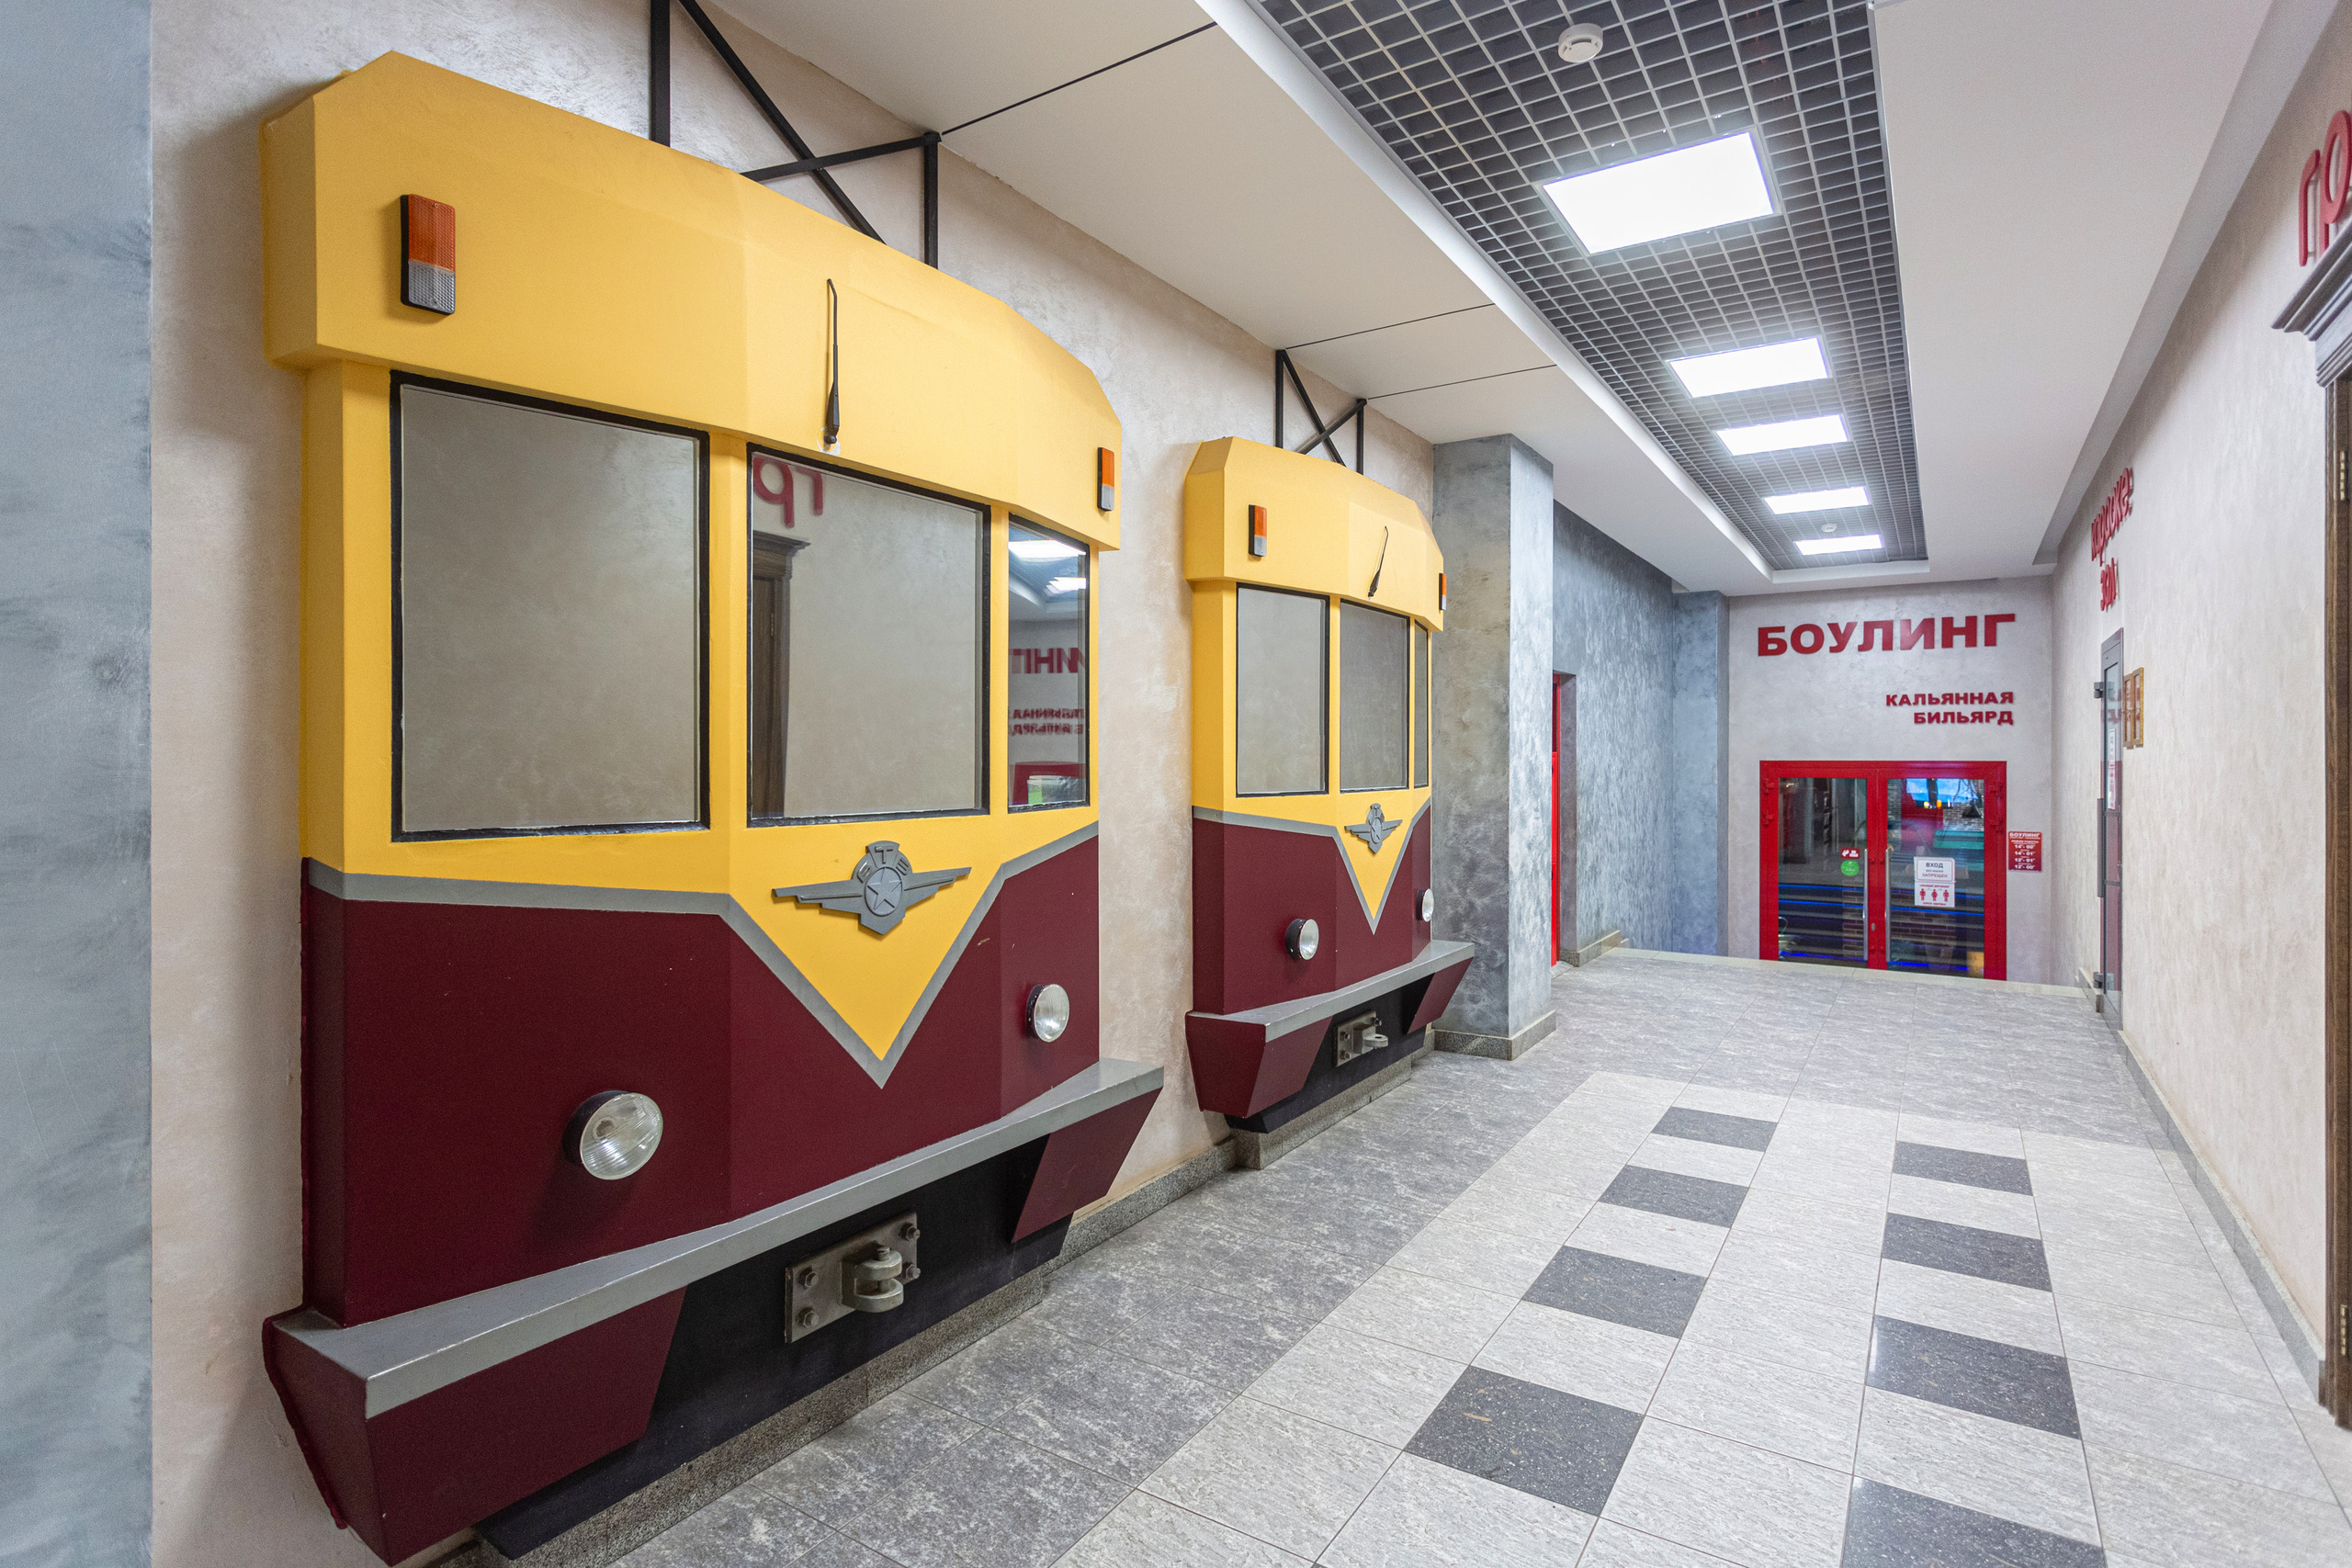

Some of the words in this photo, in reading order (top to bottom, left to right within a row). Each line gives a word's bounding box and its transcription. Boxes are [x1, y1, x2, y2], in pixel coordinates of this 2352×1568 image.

[1757, 613, 2017, 657] БОУЛИНГ
[1885, 691, 2014, 706] КАЛЬЯННАЯ
[1914, 710, 2014, 726] БИЛЬЯРД
